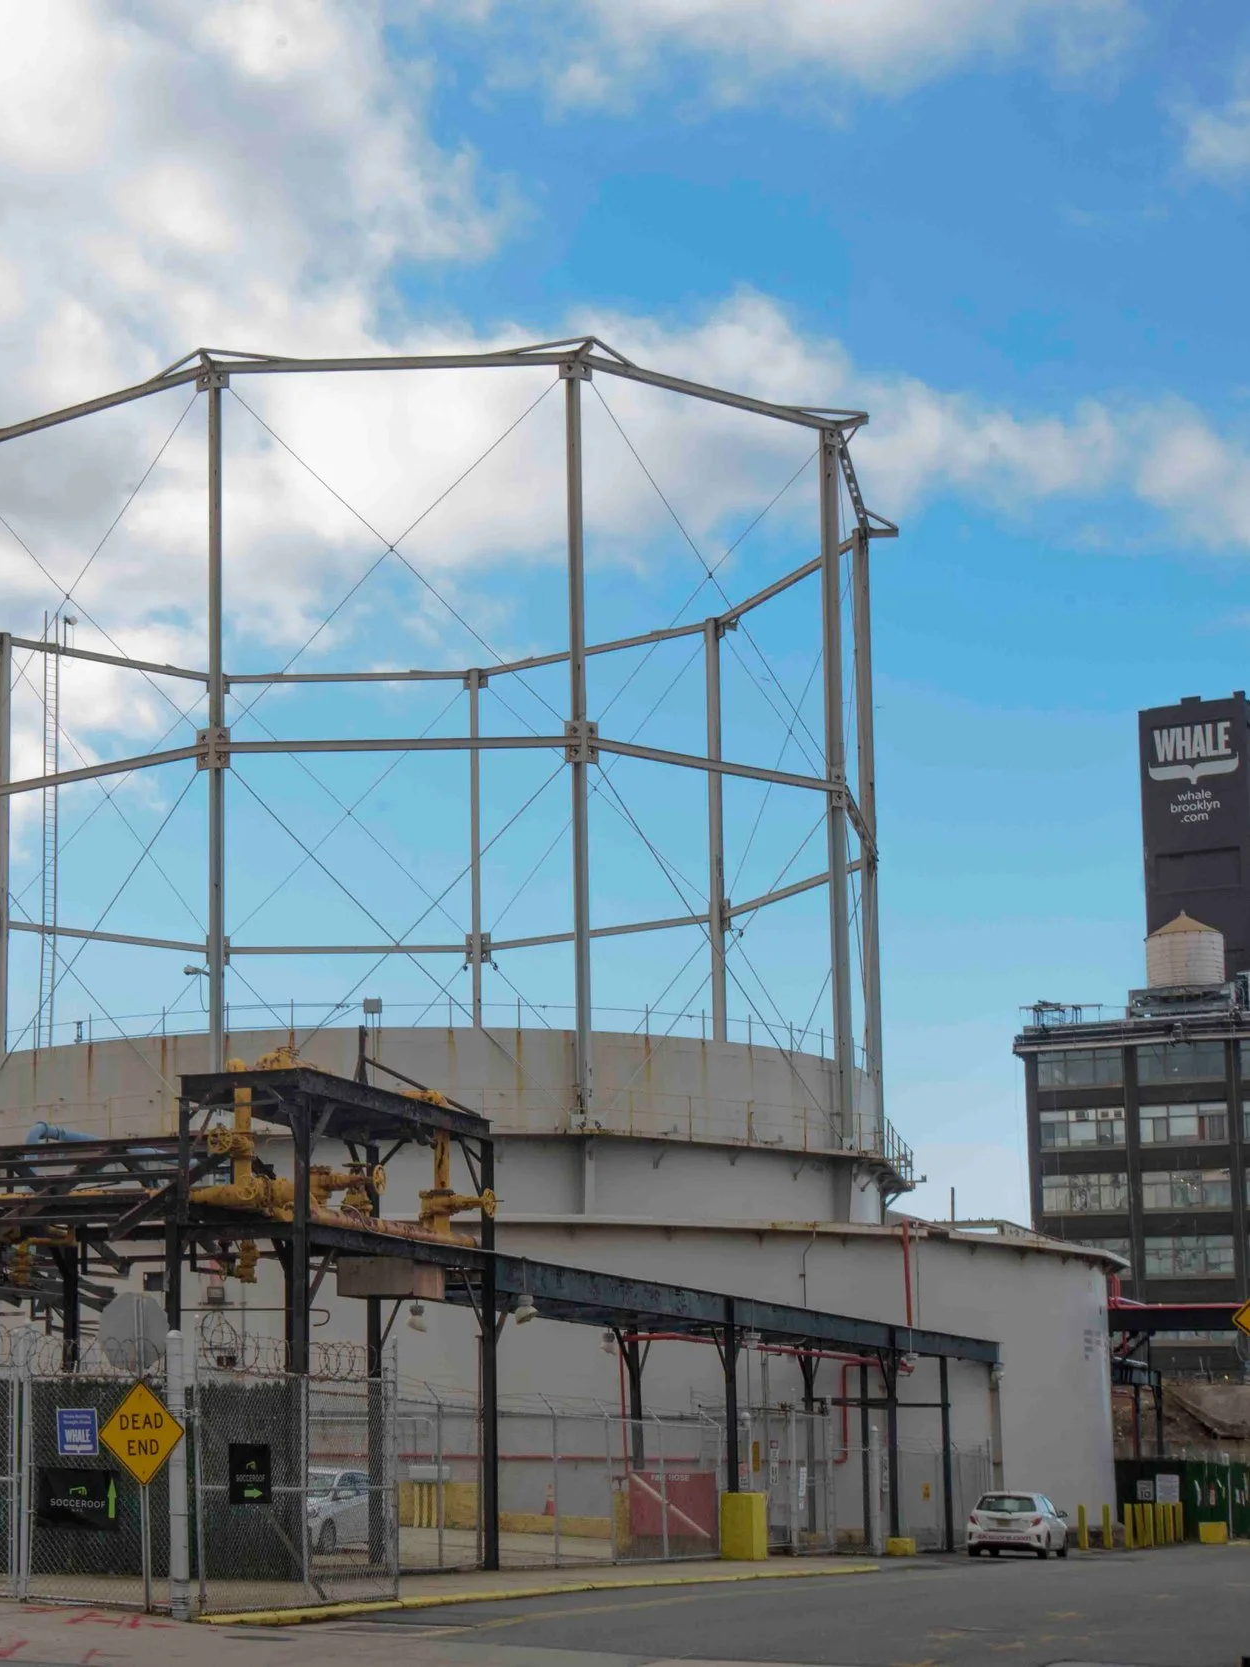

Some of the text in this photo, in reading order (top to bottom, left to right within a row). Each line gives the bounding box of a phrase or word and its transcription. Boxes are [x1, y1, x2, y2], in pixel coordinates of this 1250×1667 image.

[1153, 721, 1232, 763] WHALE
[1177, 789, 1212, 802] whale
[1170, 799, 1221, 814] brooklyn
[1180, 812, 1209, 823] .com
[119, 1412, 164, 1431] DEAD
[64, 1429, 91, 1443] WHALE
[127, 1439, 160, 1456] END
[236, 1474, 265, 1482] SOCCEROOF
[668, 1474, 690, 1482] HOSE
[49, 1498, 106, 1509] SOCCEROOF
